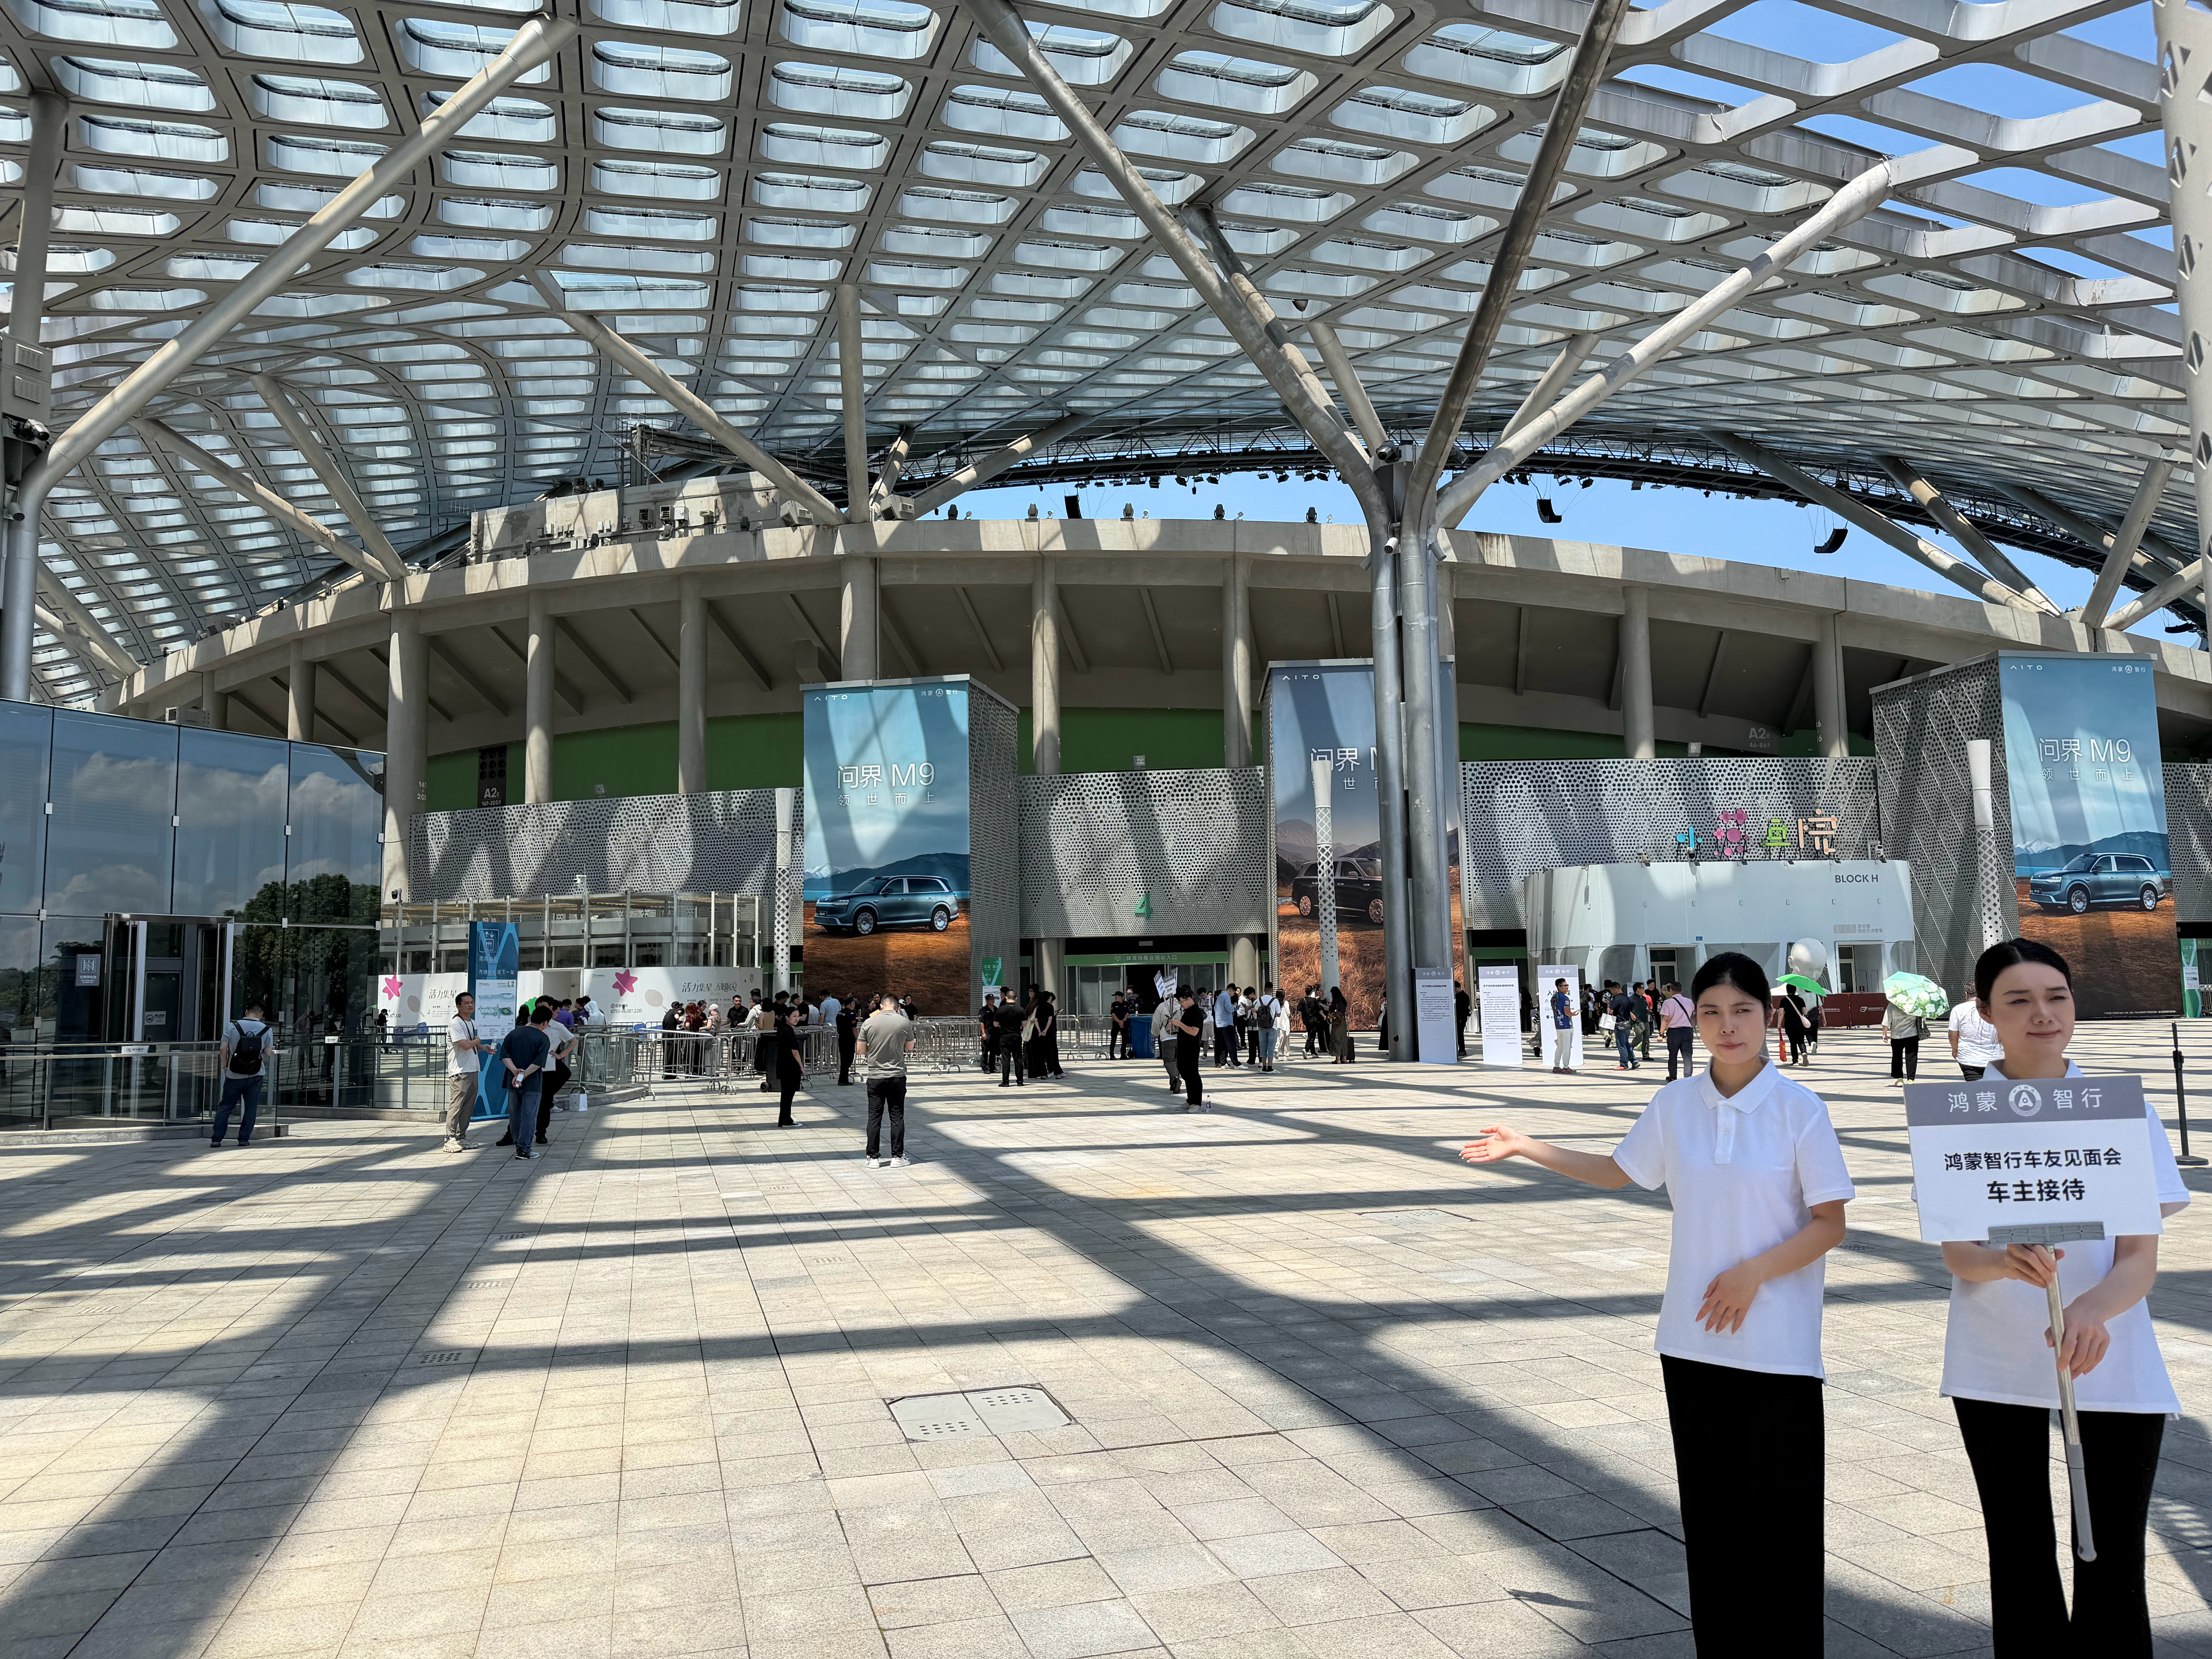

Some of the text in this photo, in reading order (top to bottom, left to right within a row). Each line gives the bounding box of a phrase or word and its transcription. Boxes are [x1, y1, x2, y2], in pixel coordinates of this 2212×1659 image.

[2039, 738, 2131, 763] 问界 M9
[837, 762, 935, 789] 问界 M9
[2042, 768, 2134, 780] 领世而上
[838, 791, 935, 806] 领世而上
[1835, 874, 1878, 883] BLOCK H
[1135, 892, 1153, 918] 4
[1948, 1088, 2102, 1112] 鸿蒙 智行
[1944, 1147, 2122, 1171] 鸿蒙智行车友见面会
[1987, 1178, 2085, 1203] 车主接待
